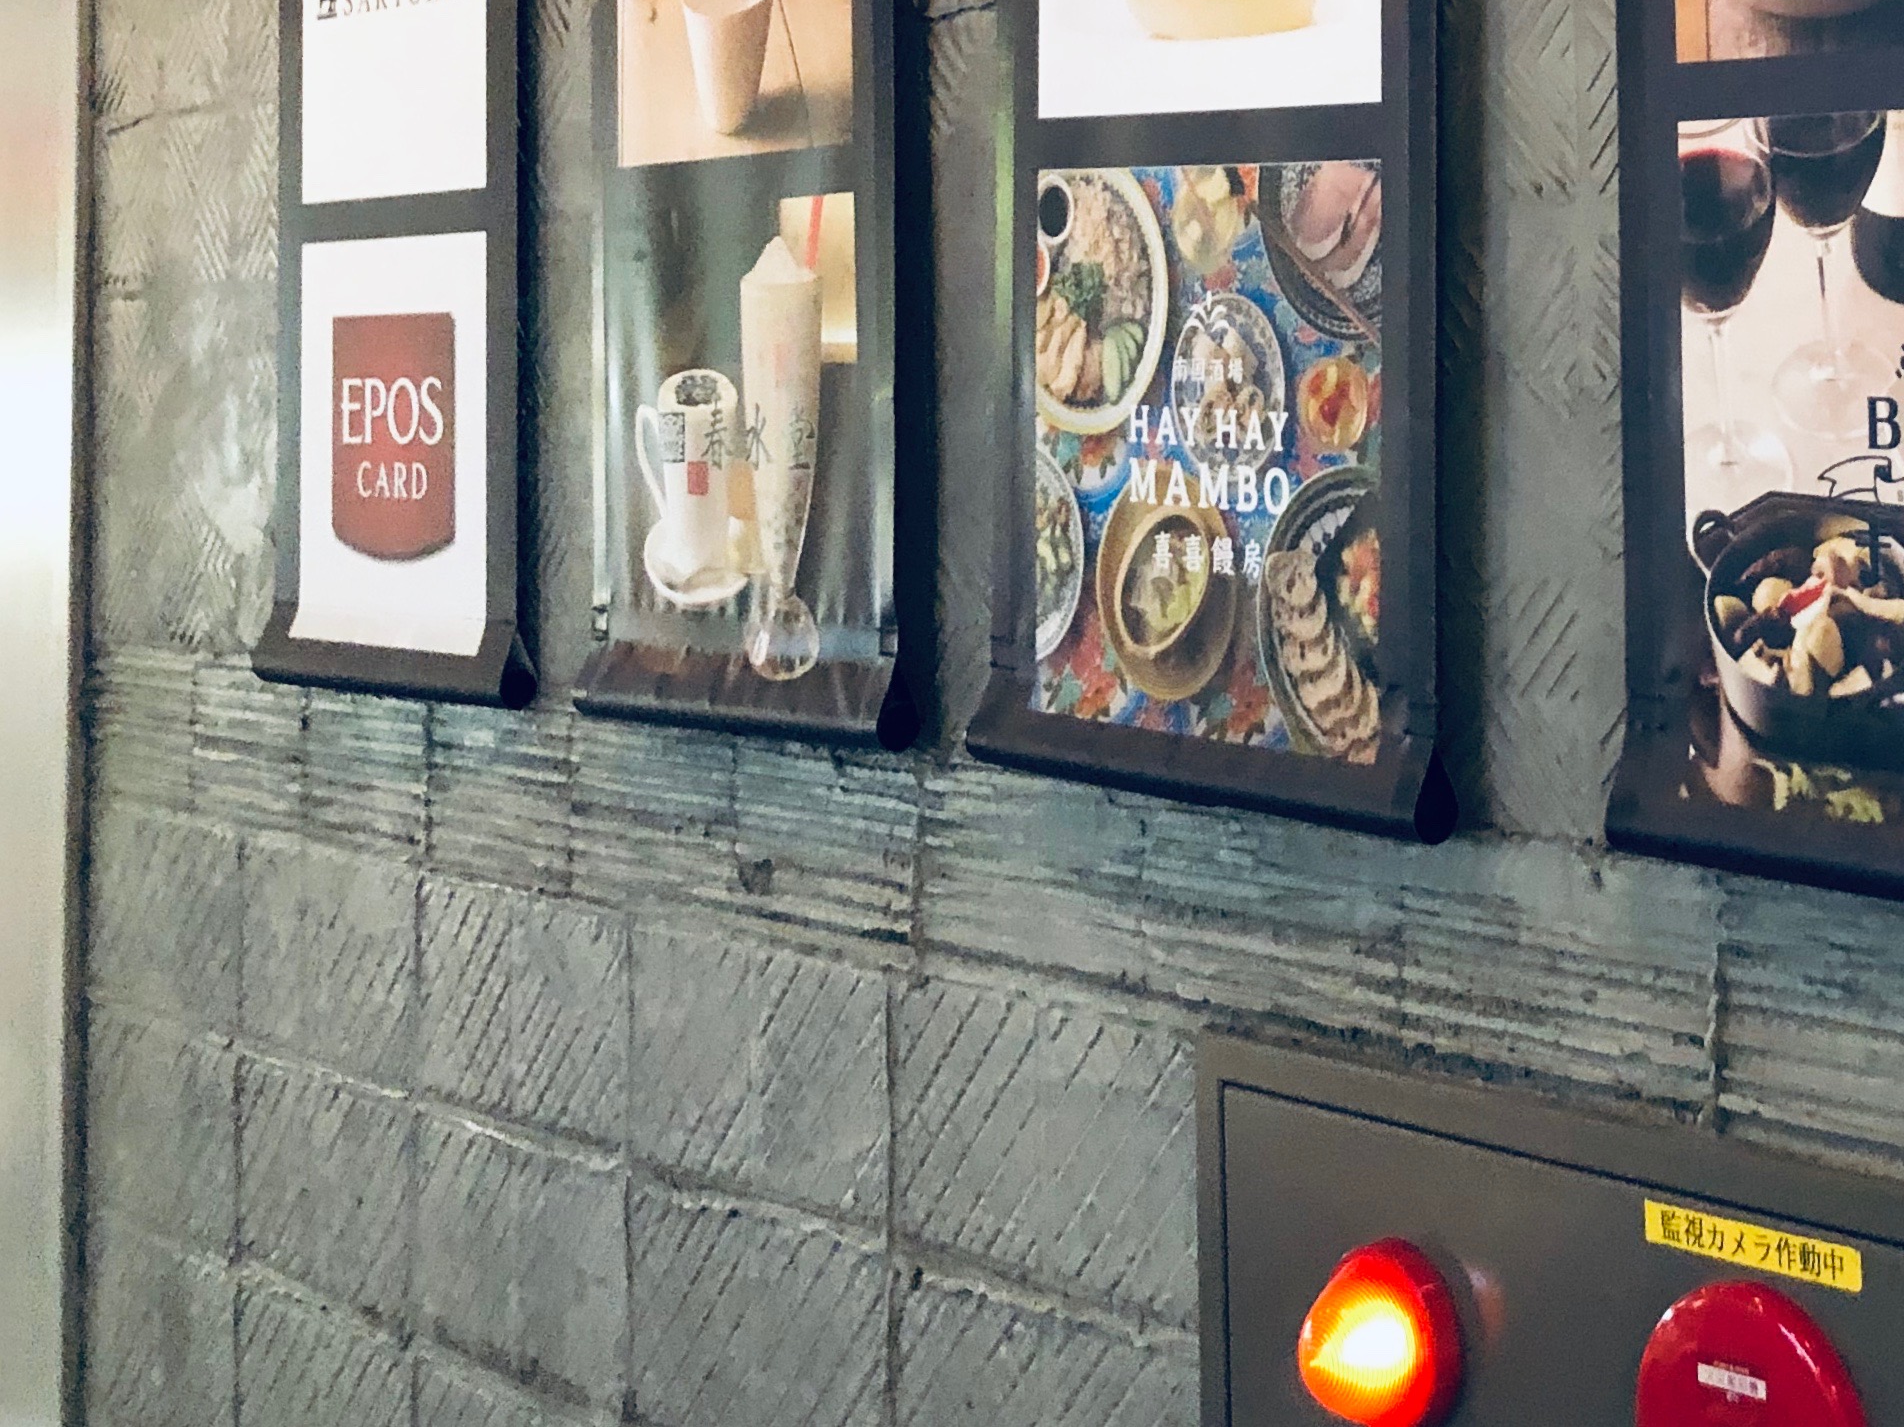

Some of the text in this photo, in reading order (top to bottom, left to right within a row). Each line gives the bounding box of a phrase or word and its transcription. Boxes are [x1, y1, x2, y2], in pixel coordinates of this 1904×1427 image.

[341, 376, 444, 446] EPOS
[1129, 404, 1289, 452] HAY HAY
[356, 460, 428, 500] CARD
[1129, 457, 1290, 515] MAMBO
[1661, 1209, 1845, 1281] 監視カメラ作動中
